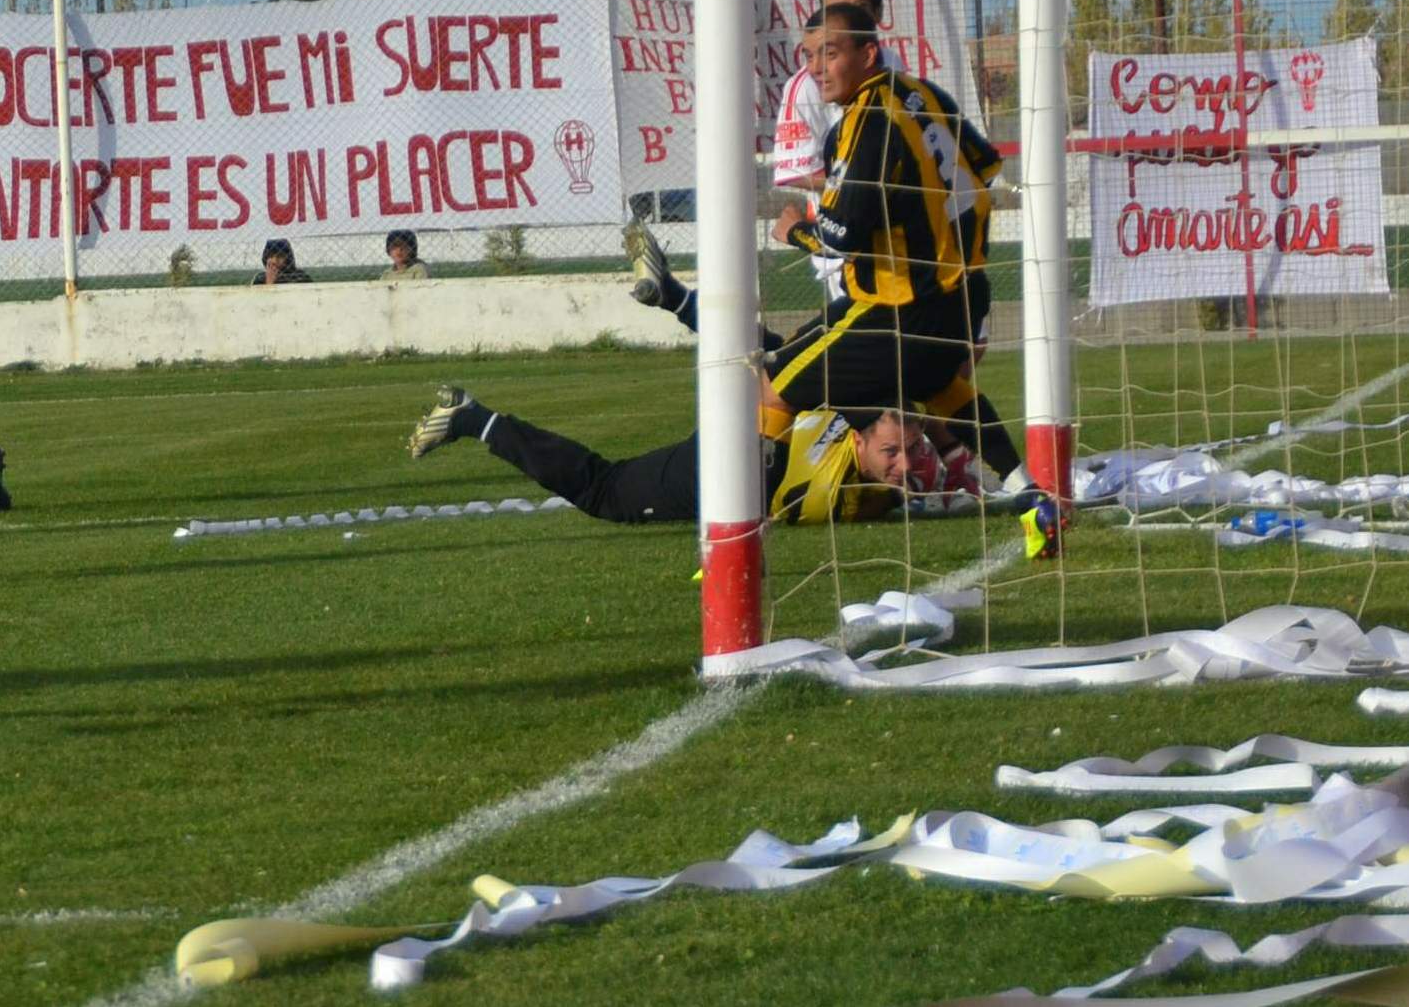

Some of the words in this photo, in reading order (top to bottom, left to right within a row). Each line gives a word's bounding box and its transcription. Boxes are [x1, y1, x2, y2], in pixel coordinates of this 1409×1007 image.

[187, 35, 289, 116] FUE
[297, 30, 355, 109] Mi
[375, 14, 562, 97] SUERTE
[1110, 58, 1277, 114] Como
[187, 154, 251, 231] ES
[265, 148, 328, 226] UN
[346, 130, 538, 218] PLACER
